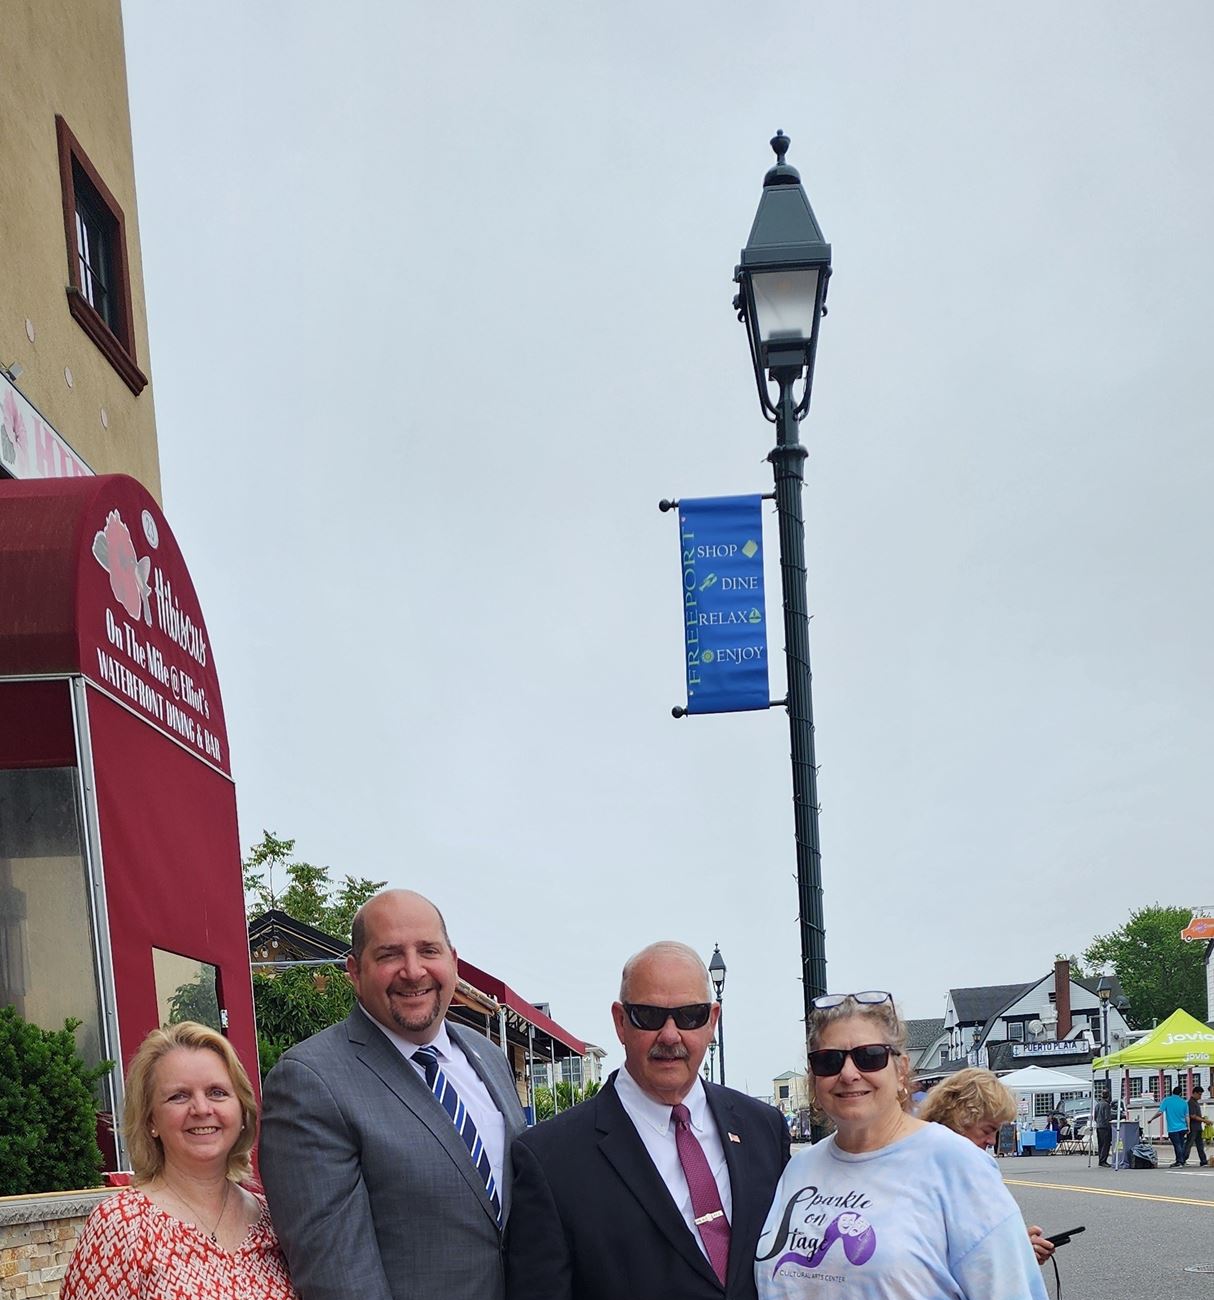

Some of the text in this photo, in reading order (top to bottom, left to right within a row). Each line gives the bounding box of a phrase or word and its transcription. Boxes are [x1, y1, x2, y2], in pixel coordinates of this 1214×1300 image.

[697, 544, 738, 558] SHOP
[721, 576, 759, 590] DINE
[681, 526, 701, 685] FREEPORT
[154, 567, 206, 668] Hibiscus
[699, 610, 749, 626] RELAX
[105, 607, 210, 720] On The Mile @ Elliot's
[716, 646, 764, 665] ENJOY
[96, 647, 222, 763] WATERFRONT DINING & BAR
[1023, 1040, 1077, 1052] PUERTO PLATA
[804, 1213, 827, 1226] on
